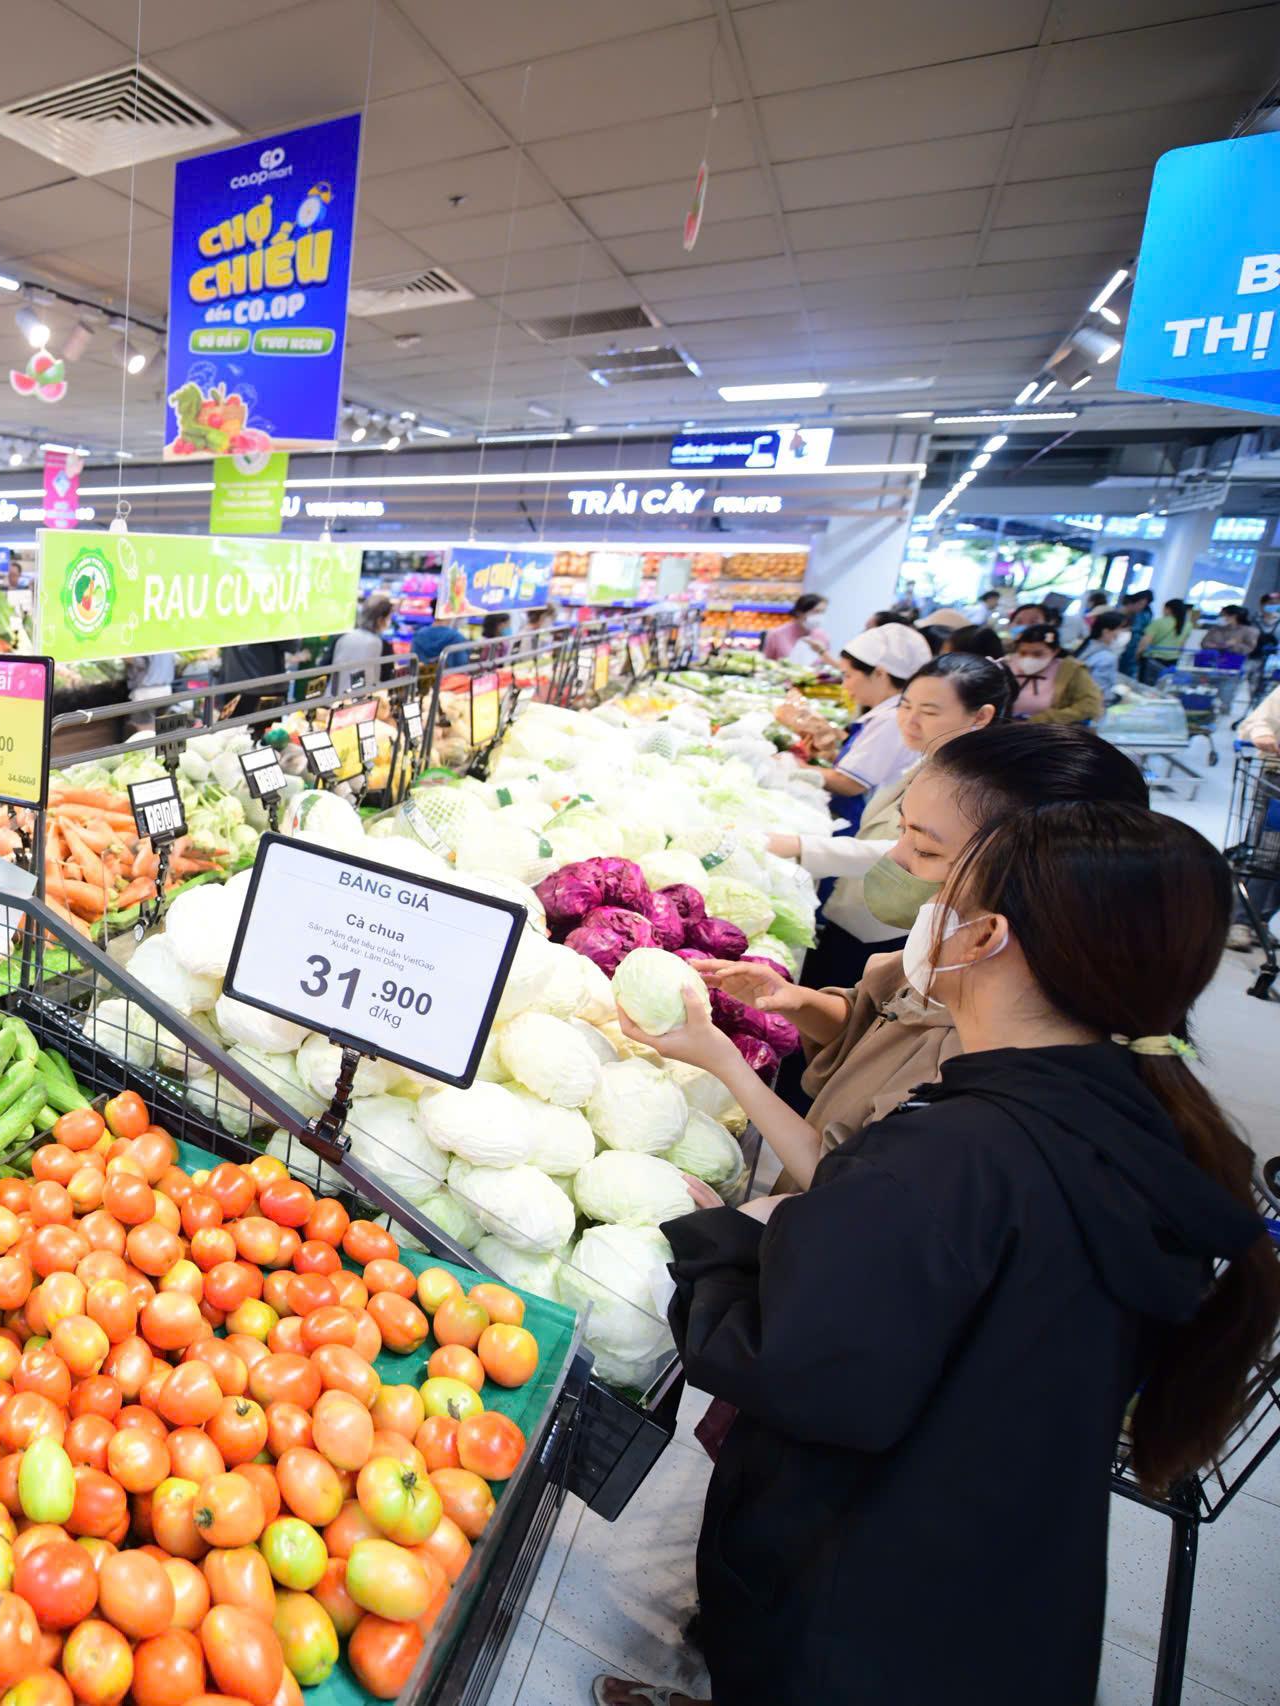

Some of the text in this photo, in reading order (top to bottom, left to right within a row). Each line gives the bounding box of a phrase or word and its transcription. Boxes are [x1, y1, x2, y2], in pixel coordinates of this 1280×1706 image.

[198, 194, 273, 258] CHỢ
[233, 292, 306, 325] CO.OP
[1163, 310, 1275, 361] THỊ
[568, 481, 783, 515] TRÁI CÂY FRUITS
[143, 573, 209, 622] RAU
[338, 870, 430, 912] BẢNG GIÁ
[307, 920, 436, 971] Sản phẩm đạt tiêu chuẩn VietGap
[345, 912, 406, 943] Cà chua
[330, 939, 350, 951] Xuất
[364, 950, 382, 963] Lâm
[382, 956, 405, 972] Đồng
[299, 953, 434, 1017] 31 .900
[368, 1004, 403, 1030] đ/kg
